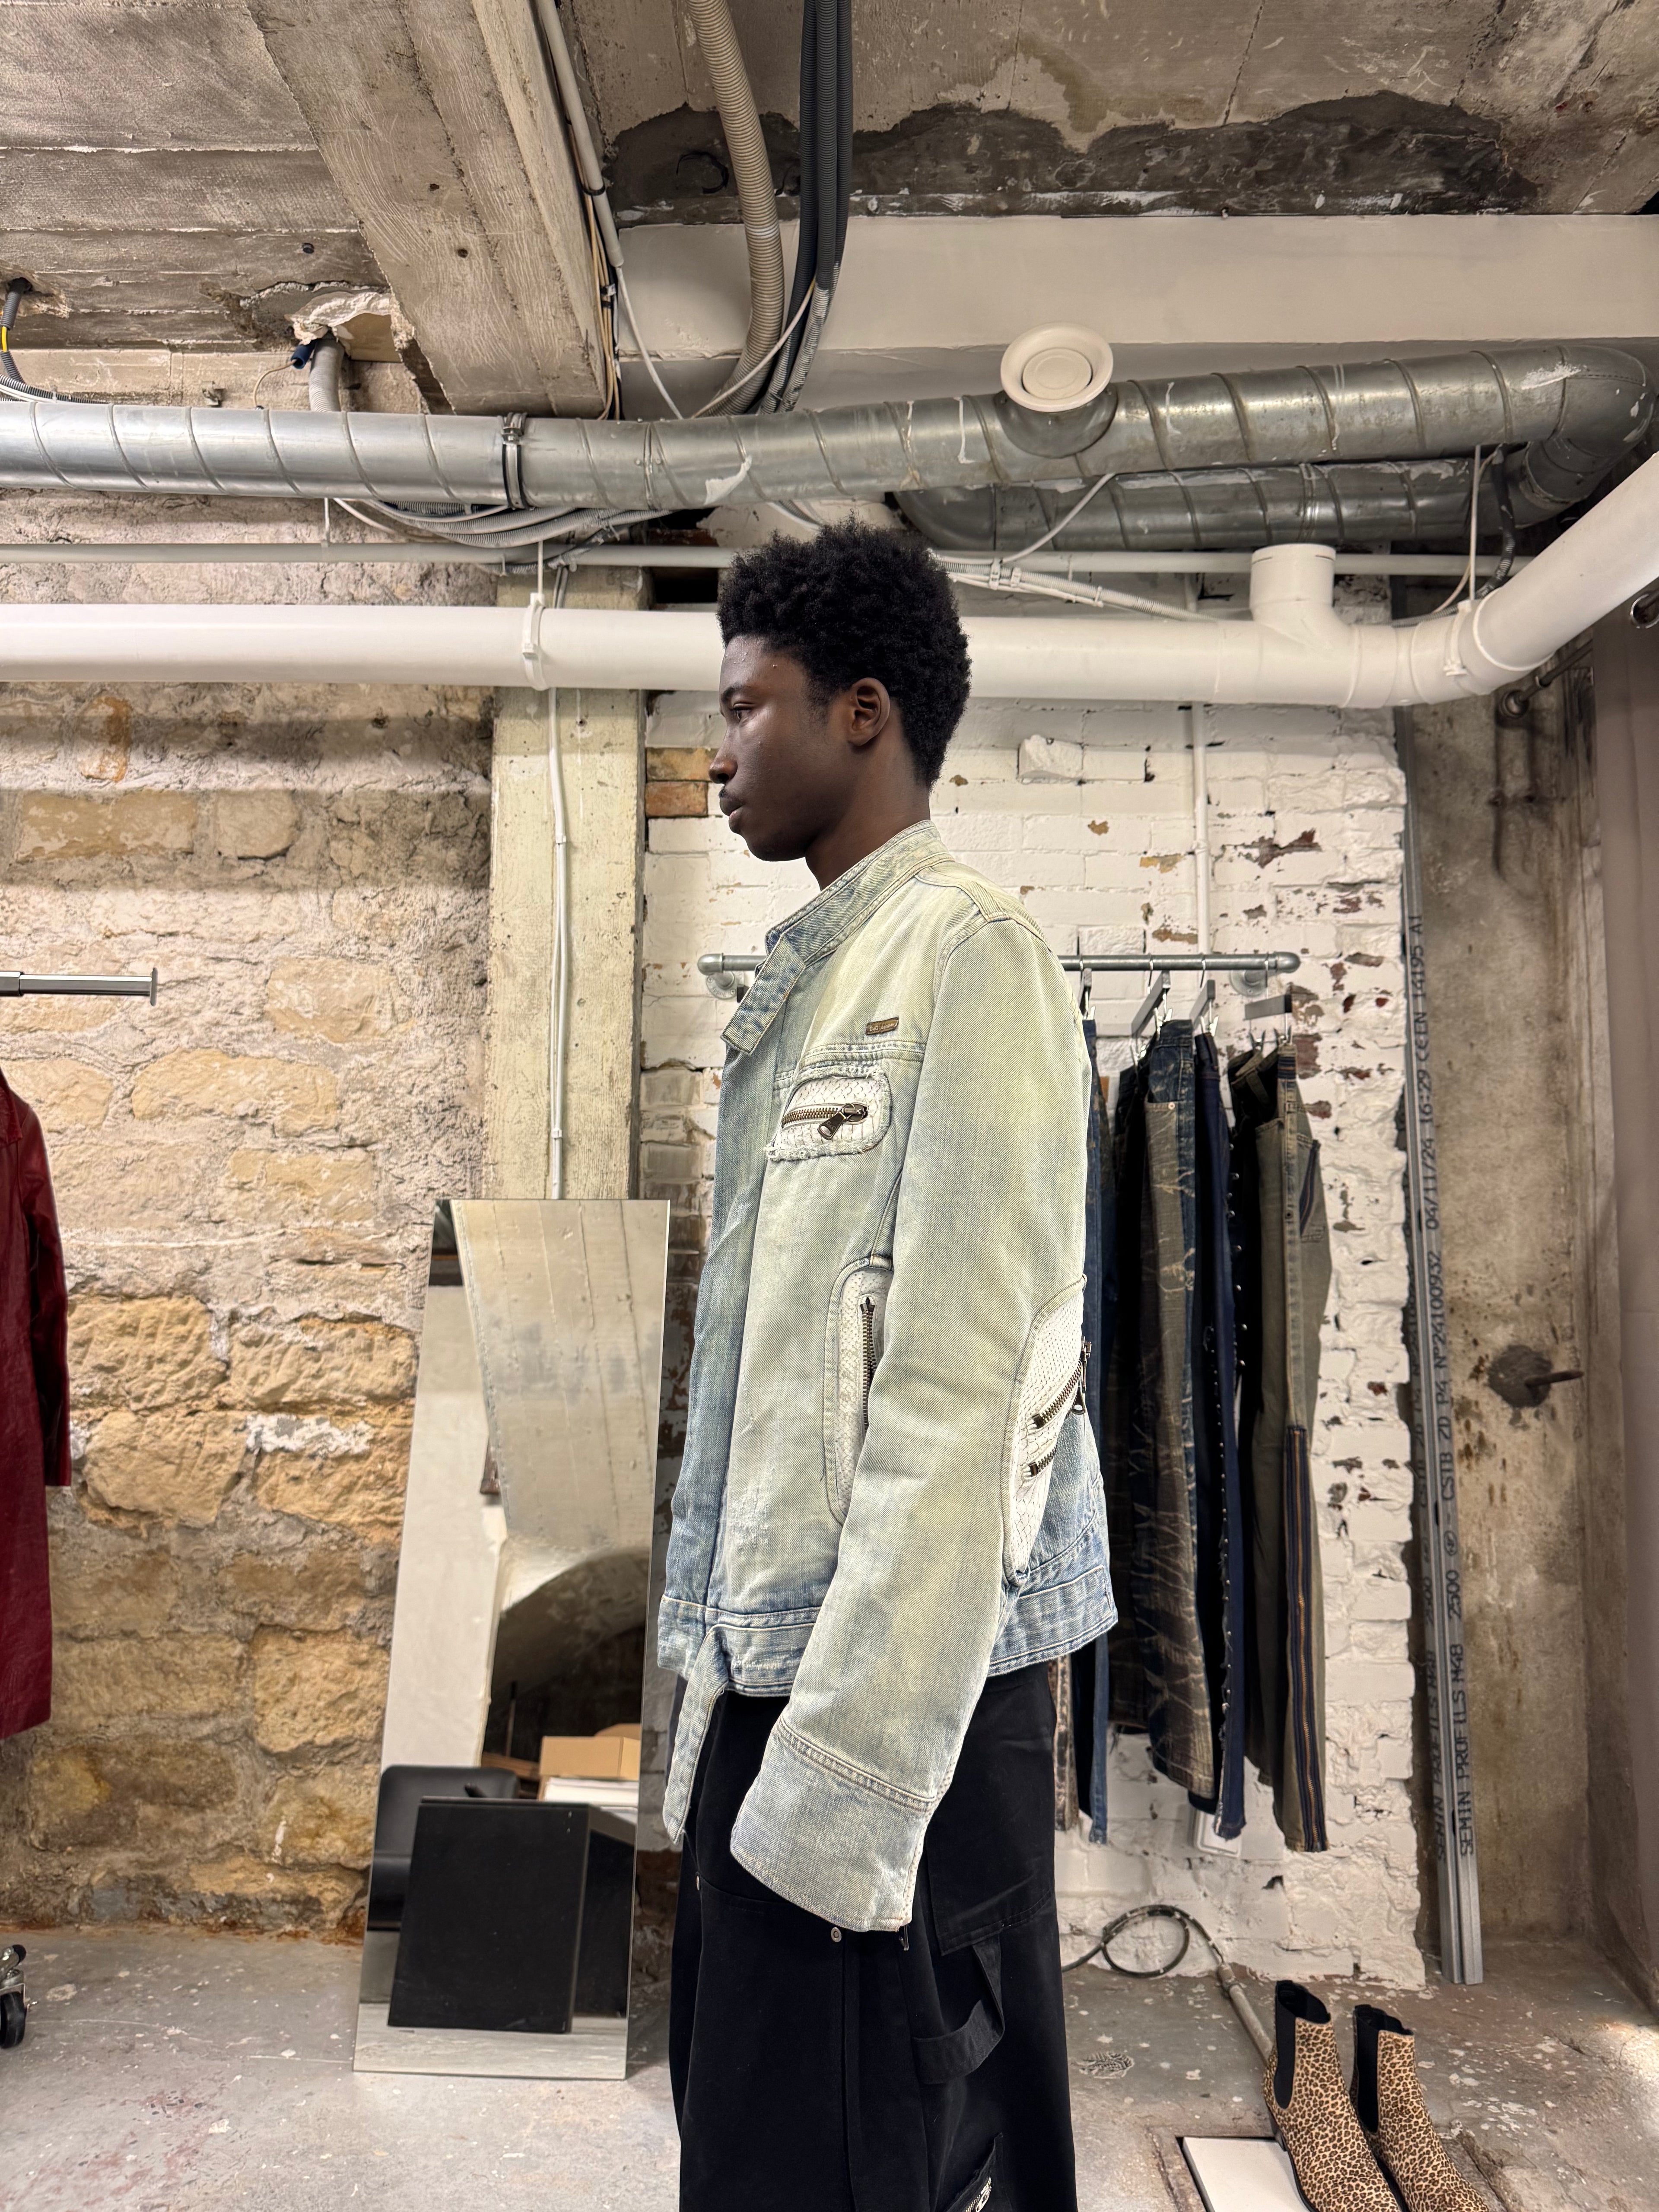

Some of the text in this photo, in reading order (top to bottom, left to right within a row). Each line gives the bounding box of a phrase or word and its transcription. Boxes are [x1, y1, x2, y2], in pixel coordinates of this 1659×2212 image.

[1410, 945, 1427, 998] 14195
[1417, 1069, 1434, 1124] 16:29
[1421, 1138, 1440, 1230] 04/11/24
[1435, 1381, 1449, 1405] P4
[1439, 1452, 1455, 1501] CSTB
[1445, 1570, 1461, 1620] 2500
[1449, 1643, 1465, 1682] M48
[1452, 1690, 1469, 1780] PROFILS
[1457, 1790, 1473, 1856] SEMIN
